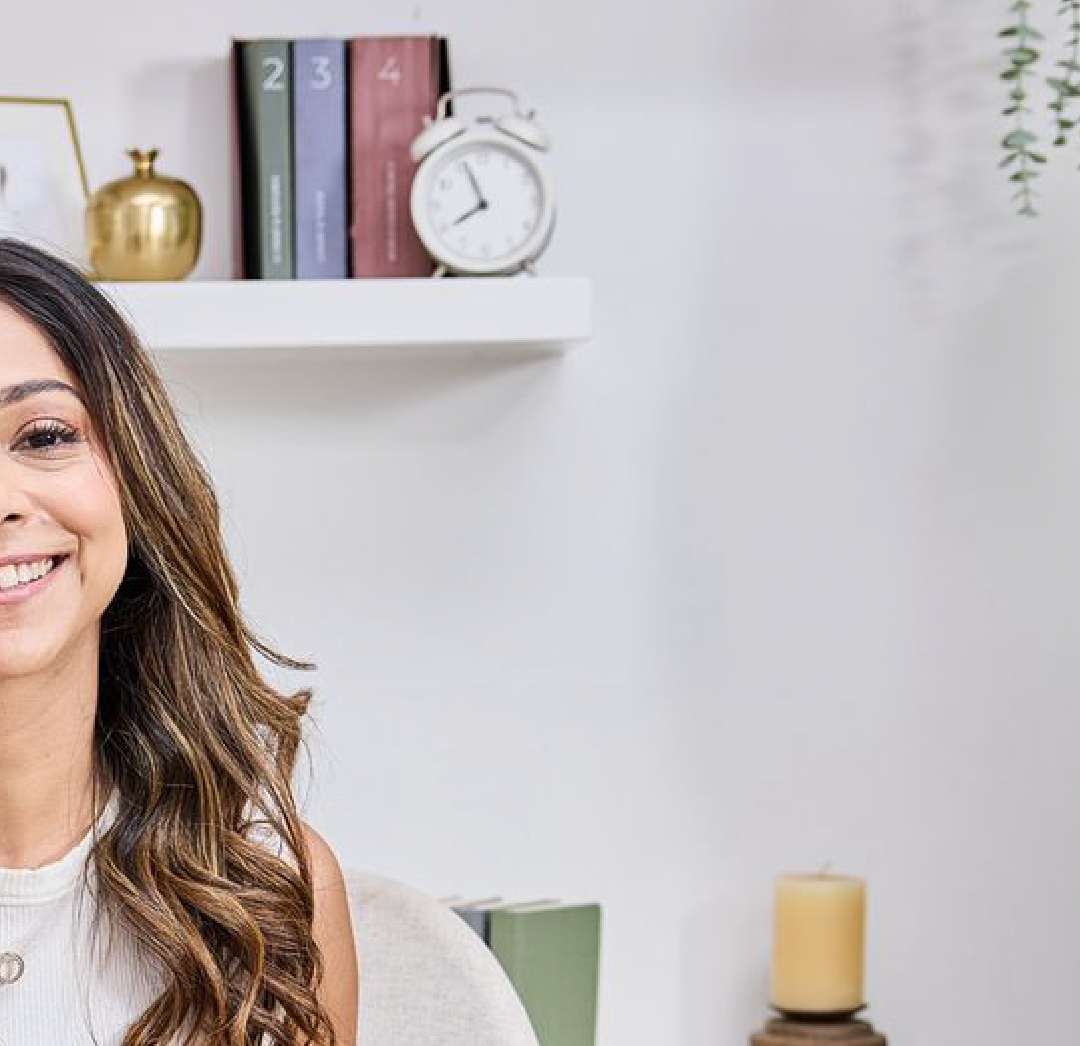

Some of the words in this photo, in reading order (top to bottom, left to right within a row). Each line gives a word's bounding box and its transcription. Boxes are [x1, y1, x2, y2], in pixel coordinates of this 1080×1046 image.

[262, 56, 286, 91] 2
[309, 56, 333, 91] 3
[377, 56, 402, 88] 4
